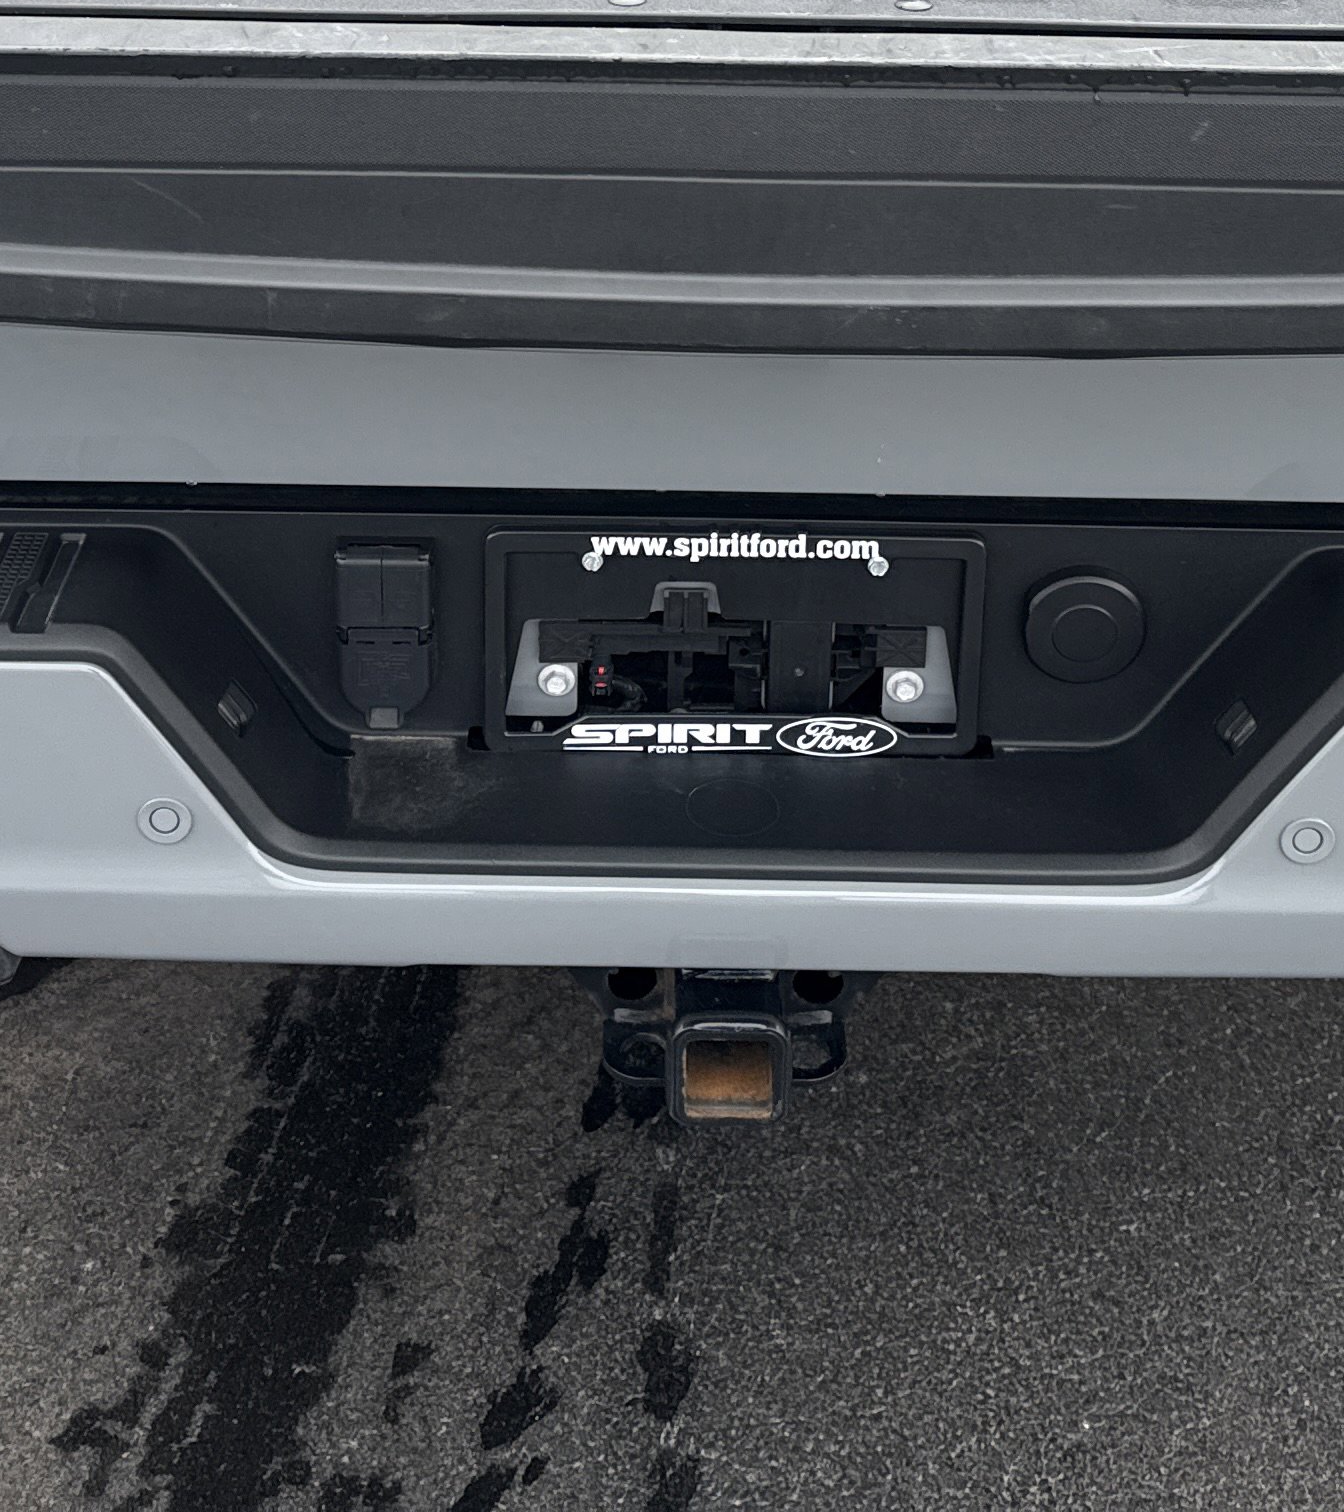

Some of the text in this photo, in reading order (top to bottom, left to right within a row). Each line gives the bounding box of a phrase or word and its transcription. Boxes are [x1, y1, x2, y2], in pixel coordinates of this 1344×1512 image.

[590, 532, 880, 562] www.spiritford.com
[562, 722, 774, 745] SPIRIT
[796, 721, 877, 752] Ford
[647, 744, 689, 754] FORD
